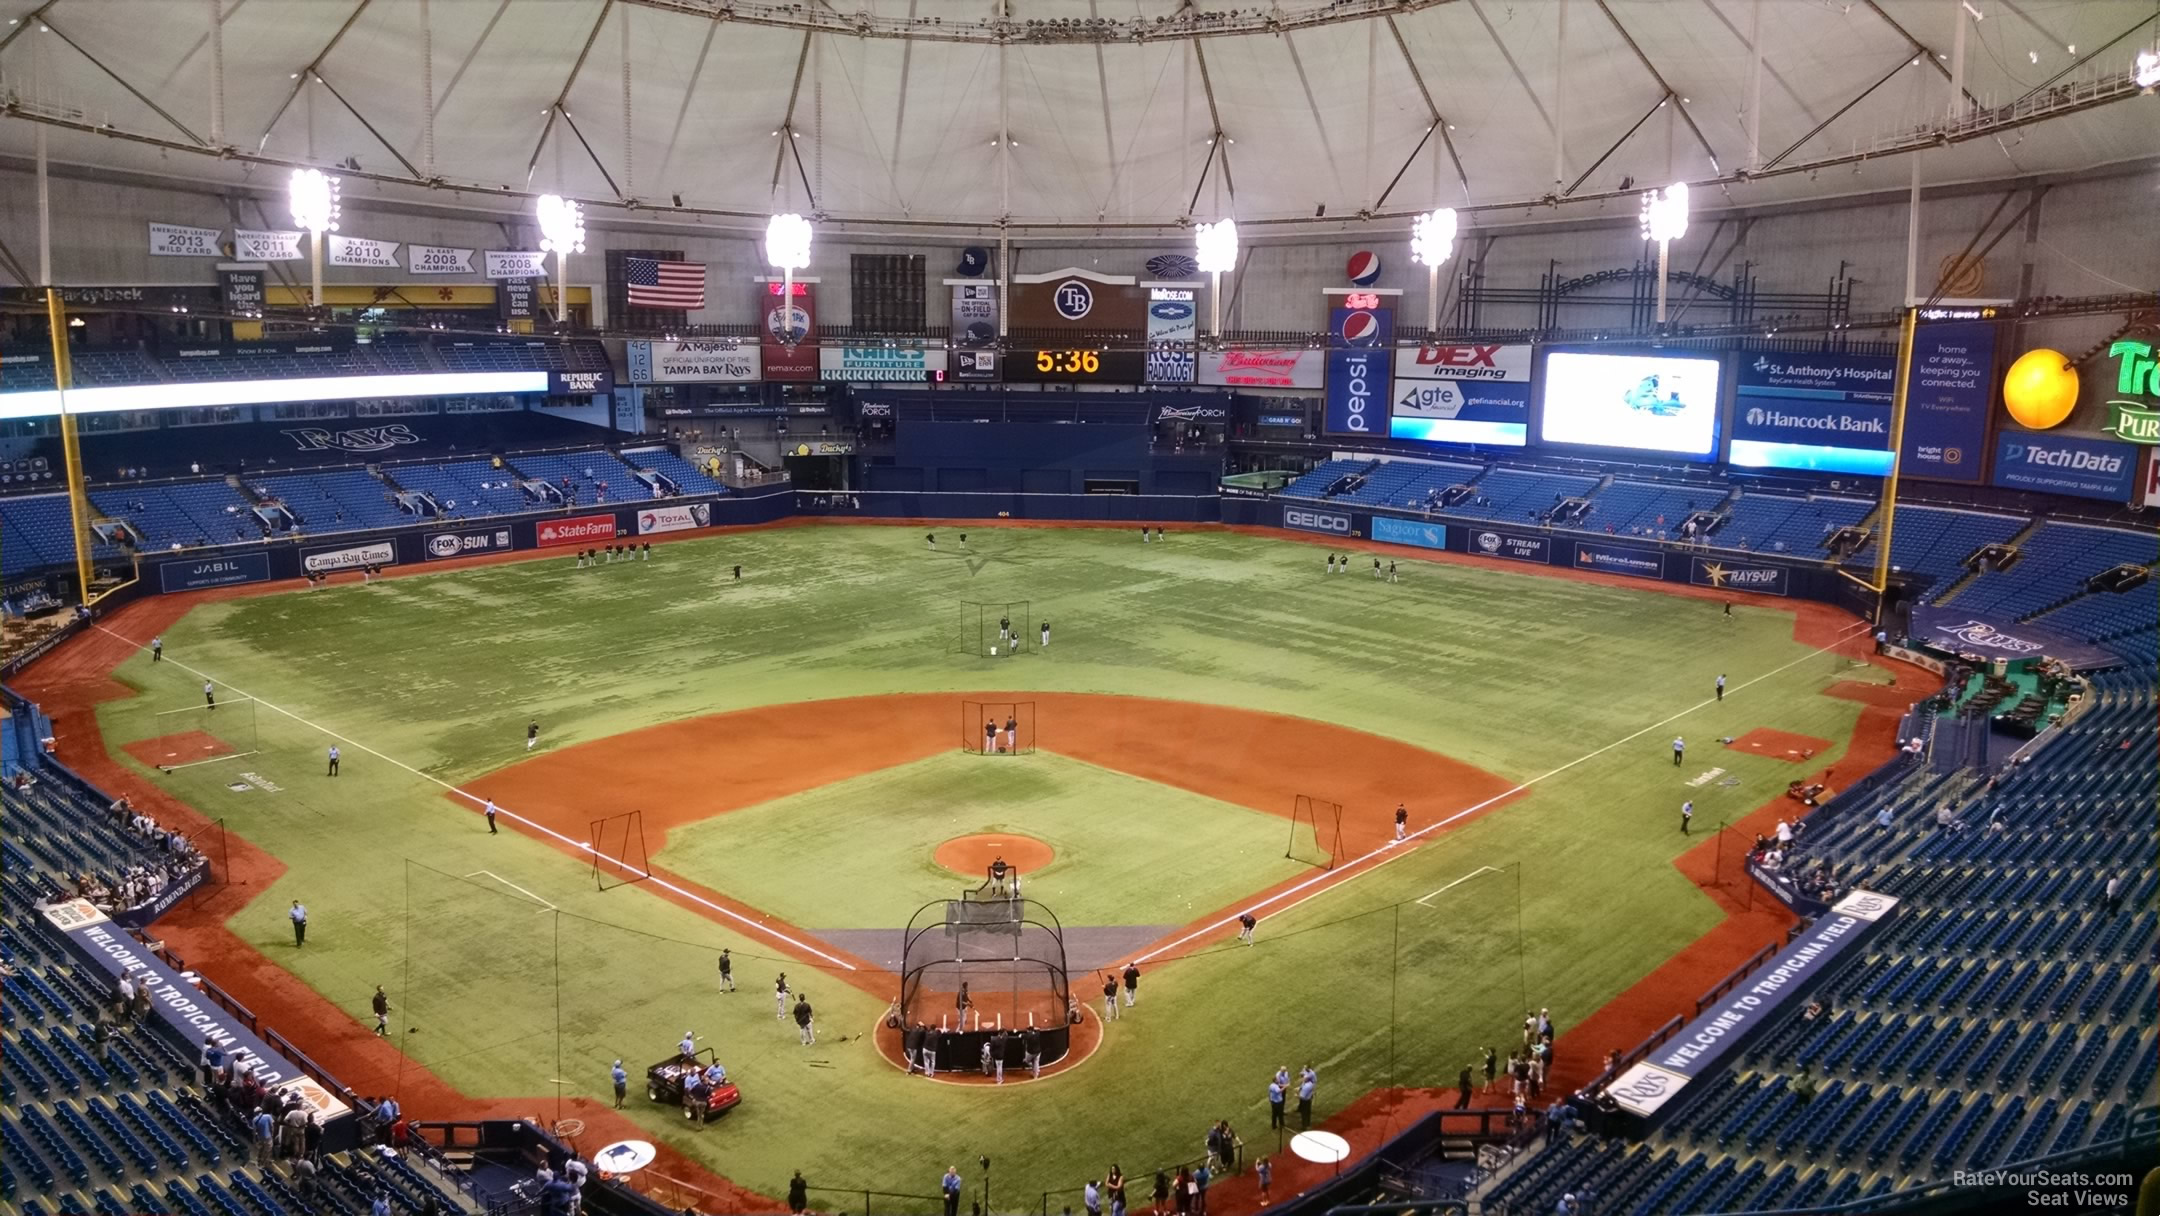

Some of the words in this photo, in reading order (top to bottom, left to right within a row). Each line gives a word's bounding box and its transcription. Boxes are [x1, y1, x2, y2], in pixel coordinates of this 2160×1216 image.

[152, 227, 188, 236] AMERICAN
[190, 230, 216, 238] LEAGUE
[168, 235, 204, 247] 2013
[254, 240, 285, 251] 2011
[158, 245, 182, 254] WILD
[186, 246, 212, 255] CARD
[244, 250, 266, 258] WILD
[345, 246, 381, 258] 2010
[334, 256, 390, 266] CHAMPIONS
[423, 254, 457, 265] 2008
[500, 259, 532, 269] 2008
[414, 264, 466, 273] CHAMPIONS
[230, 273, 257, 283] Have
[234, 284, 254, 293] you
[229, 291, 261, 300] heard
[511, 292, 528, 301] you
[1061, 288, 1087, 313] TB
[694, 342, 738, 354] Majestic
[1938, 344, 1967, 354] home
[633, 355, 645, 365] 12
[694, 356, 726, 364] UNIFORM
[1416, 344, 1504, 368] DEX
[1929, 356, 1941, 364] or
[1037, 350, 1100, 374] 5:36
[663, 366, 701, 375] TAMPA
[702, 365, 724, 375] BAY
[767, 364, 814, 373] remax.com
[1147, 363, 1193, 381] RADIOLOGY
[1434, 366, 1507, 379] imaging
[1769, 364, 1784, 375] St.
[1786, 364, 1842, 380] Anthony's
[1844, 367, 1893, 382] Hospital
[1920, 365, 1960, 378] keeping
[1961, 369, 1981, 379] you
[561, 373, 603, 382] REPUBLIC
[633, 369, 648, 381] 66
[569, 381, 596, 390] BANK
[1769, 377, 1793, 385] BayCare
[1793, 377, 1814, 386] Health
[1814, 379, 1837, 387] System
[1921, 378, 1976, 389] connected.
[1346, 357, 1371, 432] pepsi
[1422, 387, 1453, 406] gte
[1468, 397, 1525, 408] gtefinancial.org
[862, 408, 891, 416] PORCH
[1198, 409, 1225, 417] PORCH
[1766, 410, 1838, 431] Hancock
[1839, 415, 1885, 434] Bank
[697, 445, 727, 455] Ducky's
[820, 443, 852, 454] Ducky's
[1918, 445, 1942, 454] bright
[1917, 452, 1941, 460] house
[2006, 473, 2036, 484] PROUDLY
[2036, 476, 2078, 489] SUPPORTING
[2080, 482, 2102, 491] TAMPA
[2103, 485, 2117, 493] BAY
[658, 514, 690, 524] TOTAL
[1286, 511, 1349, 531] GEICO
[558, 525, 585, 539] State
[585, 522, 613, 535] Farm
[1379, 519, 1420, 536] Sagicor
[436, 539, 456, 549] FOX
[463, 535, 489, 550] SUN
[1506, 538, 1541, 550] STREAM
[1514, 547, 1532, 556] LIVE
[310, 556, 341, 569] Tampa
[341, 553, 362, 565] Bay
[362, 550, 390, 562] Times
[193, 561, 239, 575] JABIL
[9, 579, 47, 595] LANDING
[83, 926, 144, 974] WELCOME
[137, 969, 160, 987] TO
[155, 982, 239, 1053] TROPICANA
[1664, 1011, 1743, 1068] WELCOME
[1735, 995, 1759, 1015] TO
[1752, 942, 1825, 1000] TROPICANA
[1818, 916, 1857, 944] FIELD
[1613, 1072, 1670, 1106] RAYS
